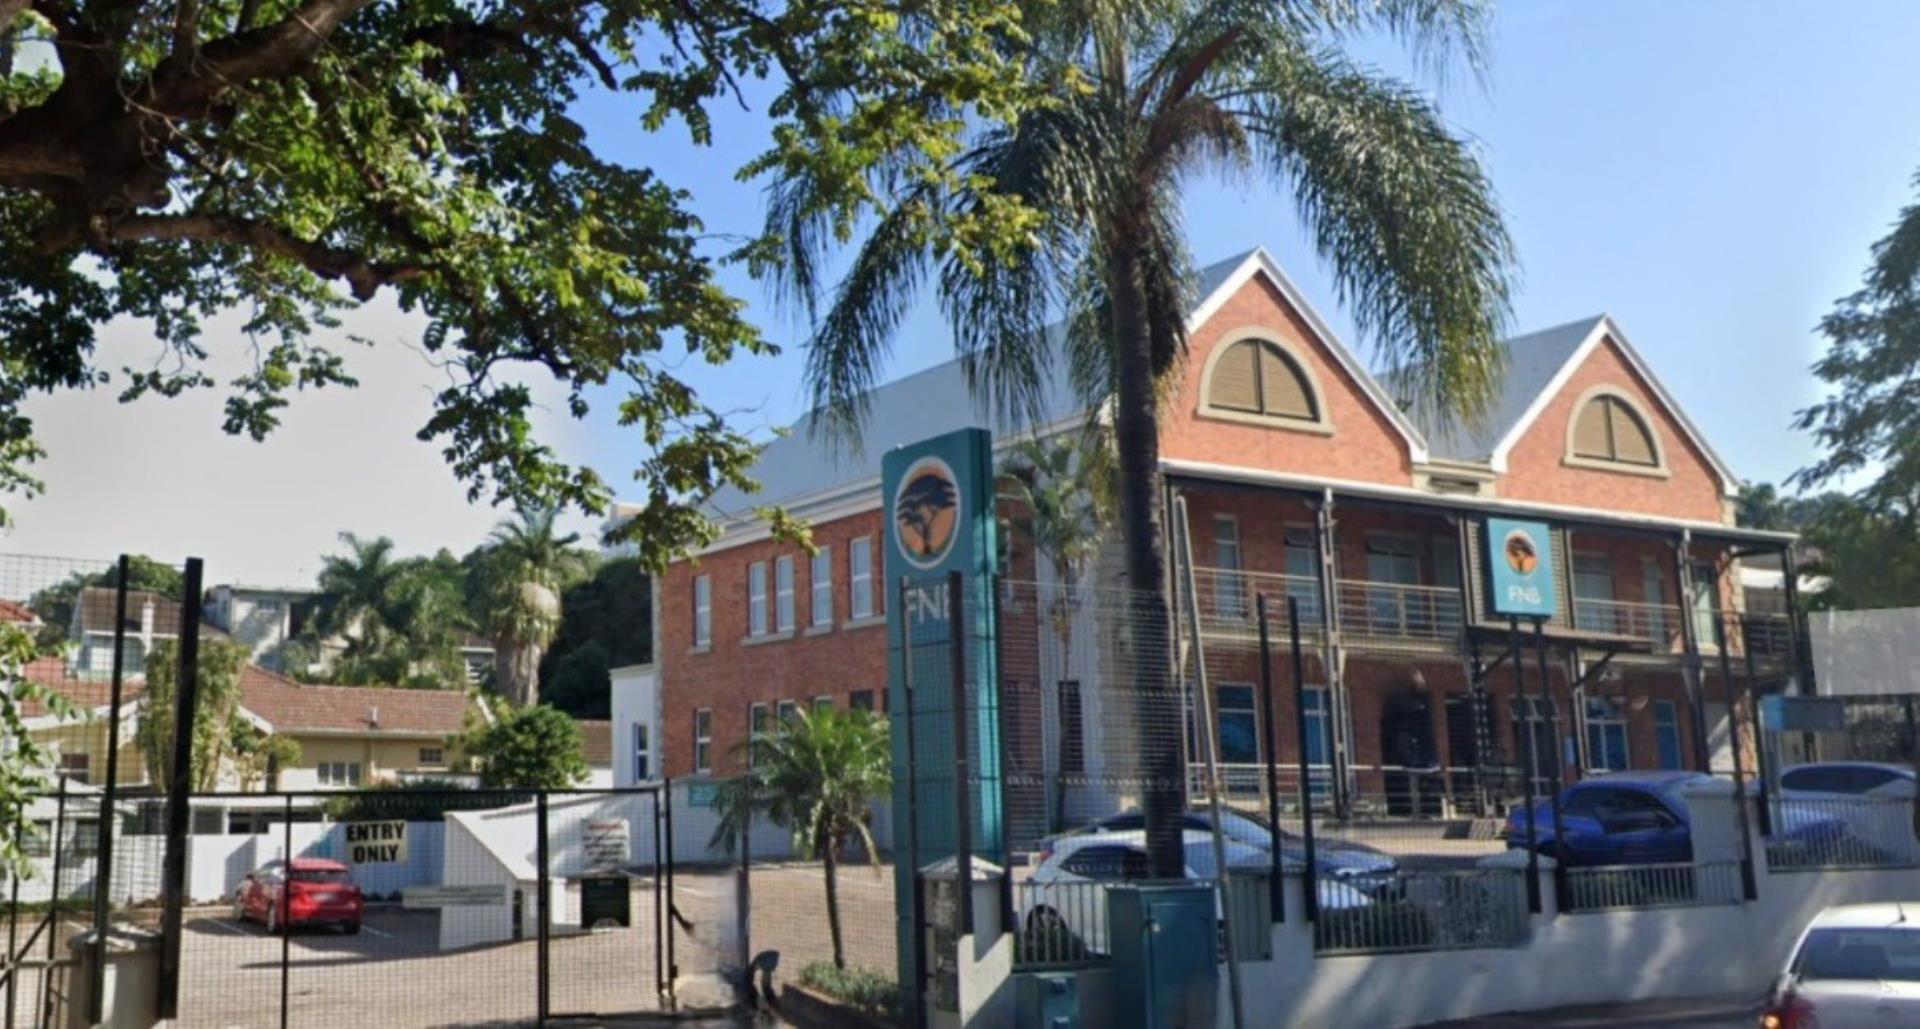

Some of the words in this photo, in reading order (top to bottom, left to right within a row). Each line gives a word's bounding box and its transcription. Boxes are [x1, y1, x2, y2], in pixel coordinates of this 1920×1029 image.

[1508, 585, 1541, 605] FNB
[346, 822, 405, 841] ENTRY
[353, 844, 399, 864] ONLY
